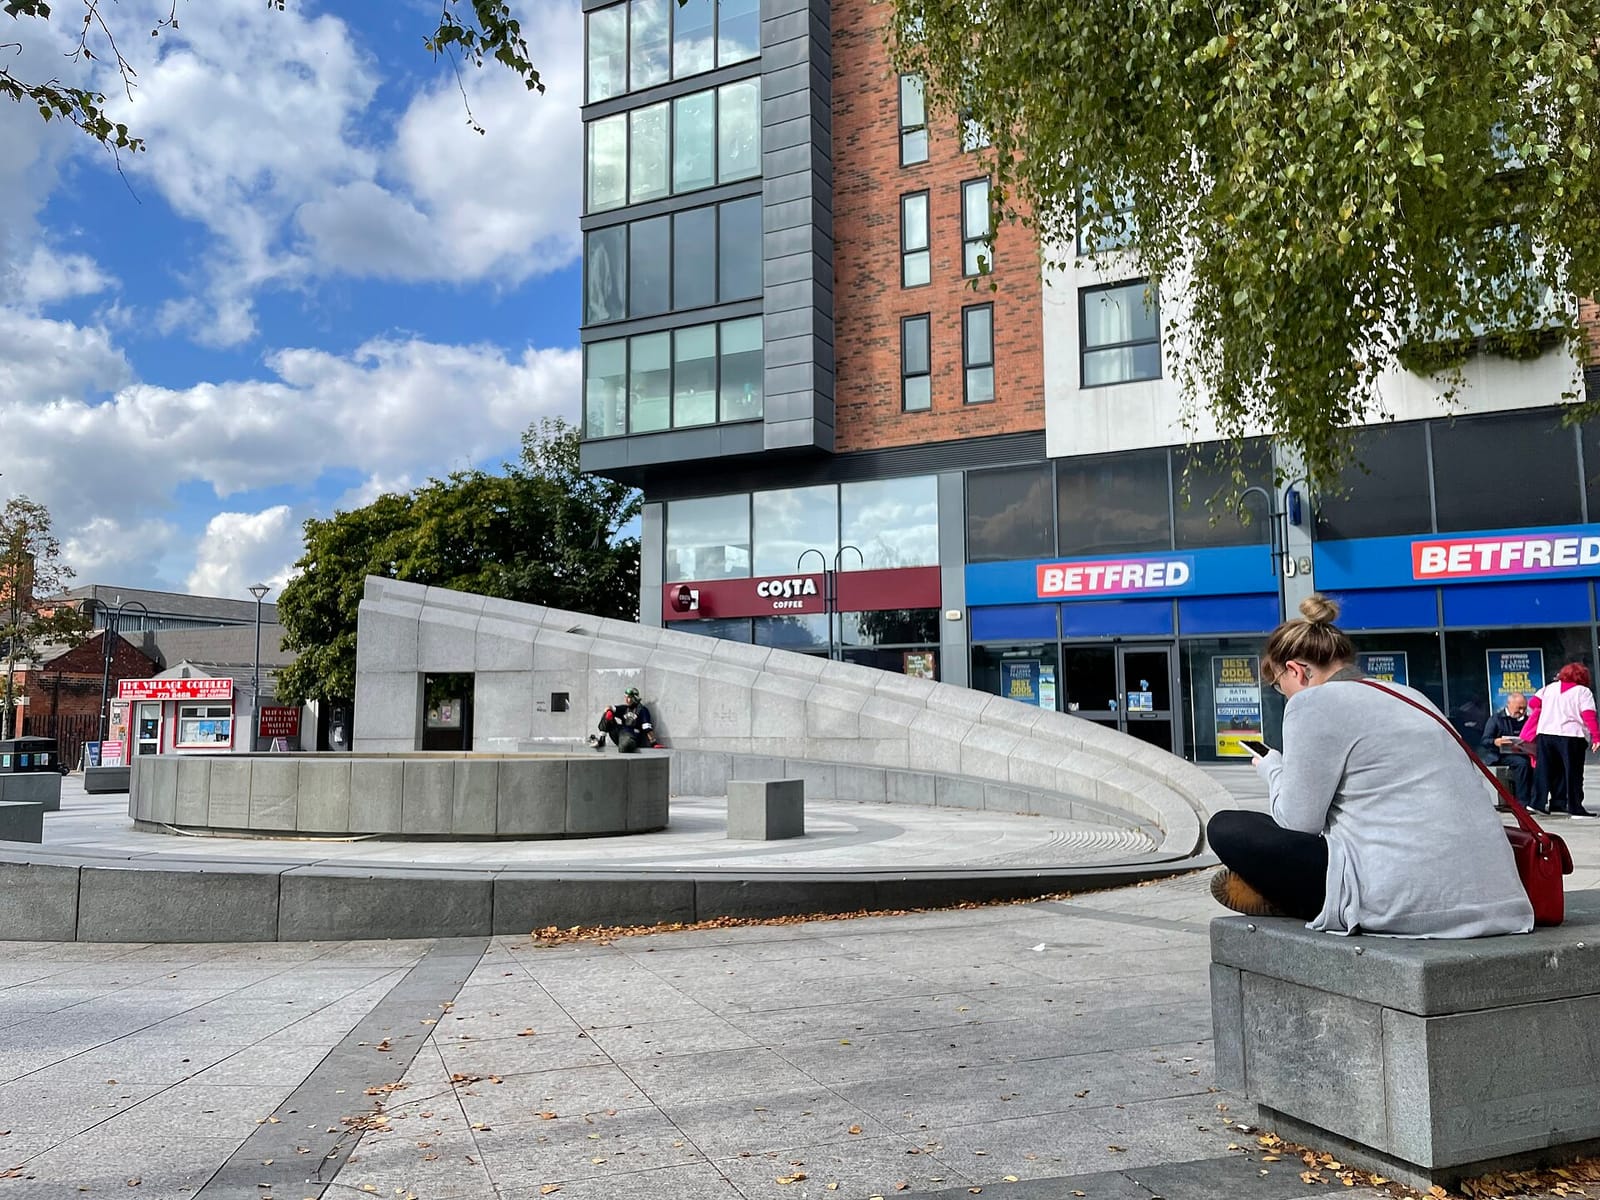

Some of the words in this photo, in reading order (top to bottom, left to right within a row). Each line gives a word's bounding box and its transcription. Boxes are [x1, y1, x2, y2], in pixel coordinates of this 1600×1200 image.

[1420, 536, 1600, 574] BETFRED
[1043, 561, 1190, 592] BETFRED
[757, 578, 817, 598] COSTA
[773, 600, 803, 609] COFFEE
[1222, 658, 1248, 668] BEST
[1221, 668, 1252, 678] ODDS
[1503, 672, 1529, 681] BEST
[122, 681, 139, 690] THE
[143, 681, 182, 690] VILLAGE
[186, 680, 230, 689] COBBLER
[1503, 680, 1531, 689] ODDS
[1217, 707, 1258, 715] SOUTHWELL
